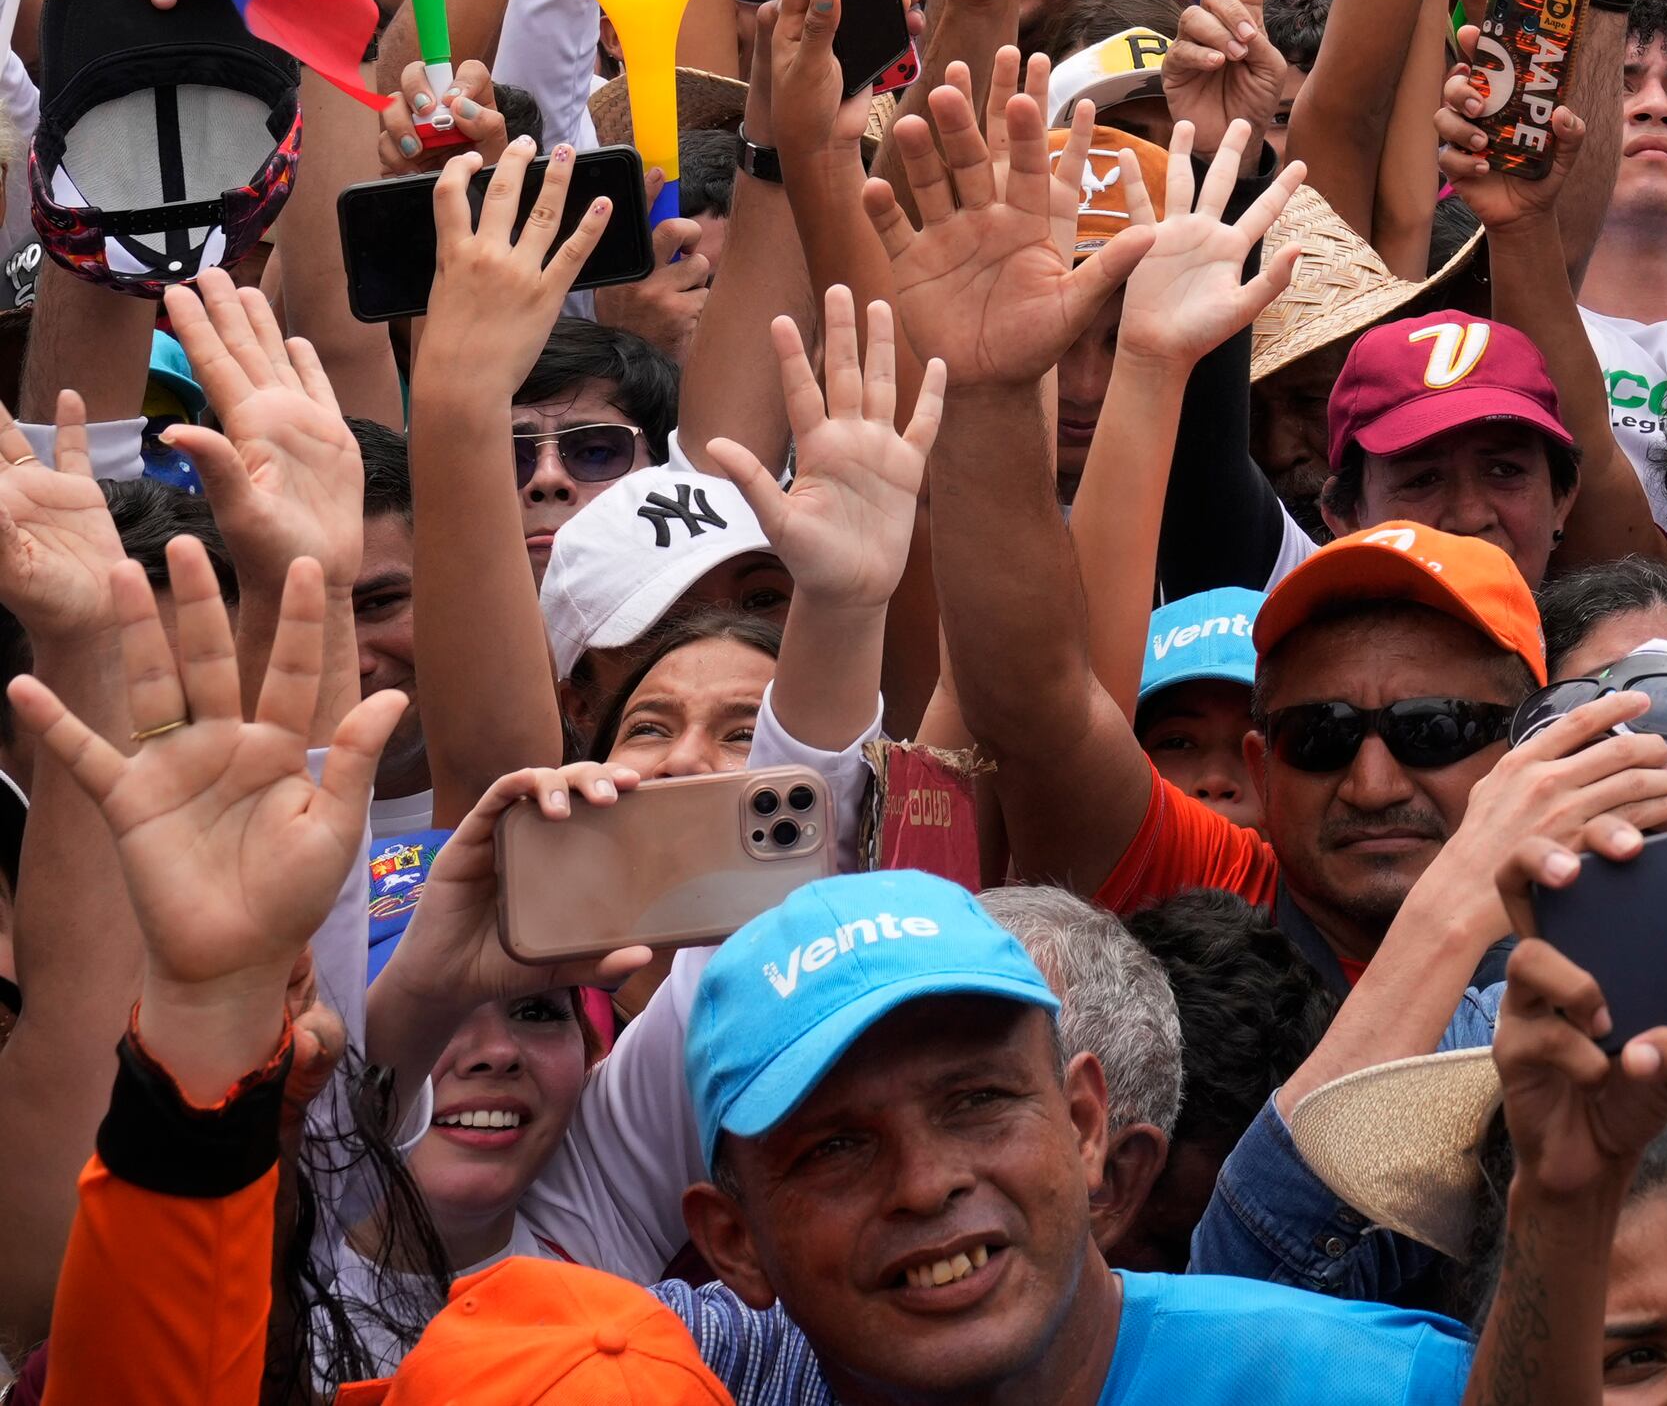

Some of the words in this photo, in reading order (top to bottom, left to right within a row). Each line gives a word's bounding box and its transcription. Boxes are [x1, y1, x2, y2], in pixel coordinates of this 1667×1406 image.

[1124, 34, 1169, 70] P
[1543, 16, 1567, 30] Aape
[1512, 33, 1566, 153] AAPE
[1408, 321, 1490, 389] V
[636, 483, 728, 548] NY
[762, 912, 940, 999] Vente
